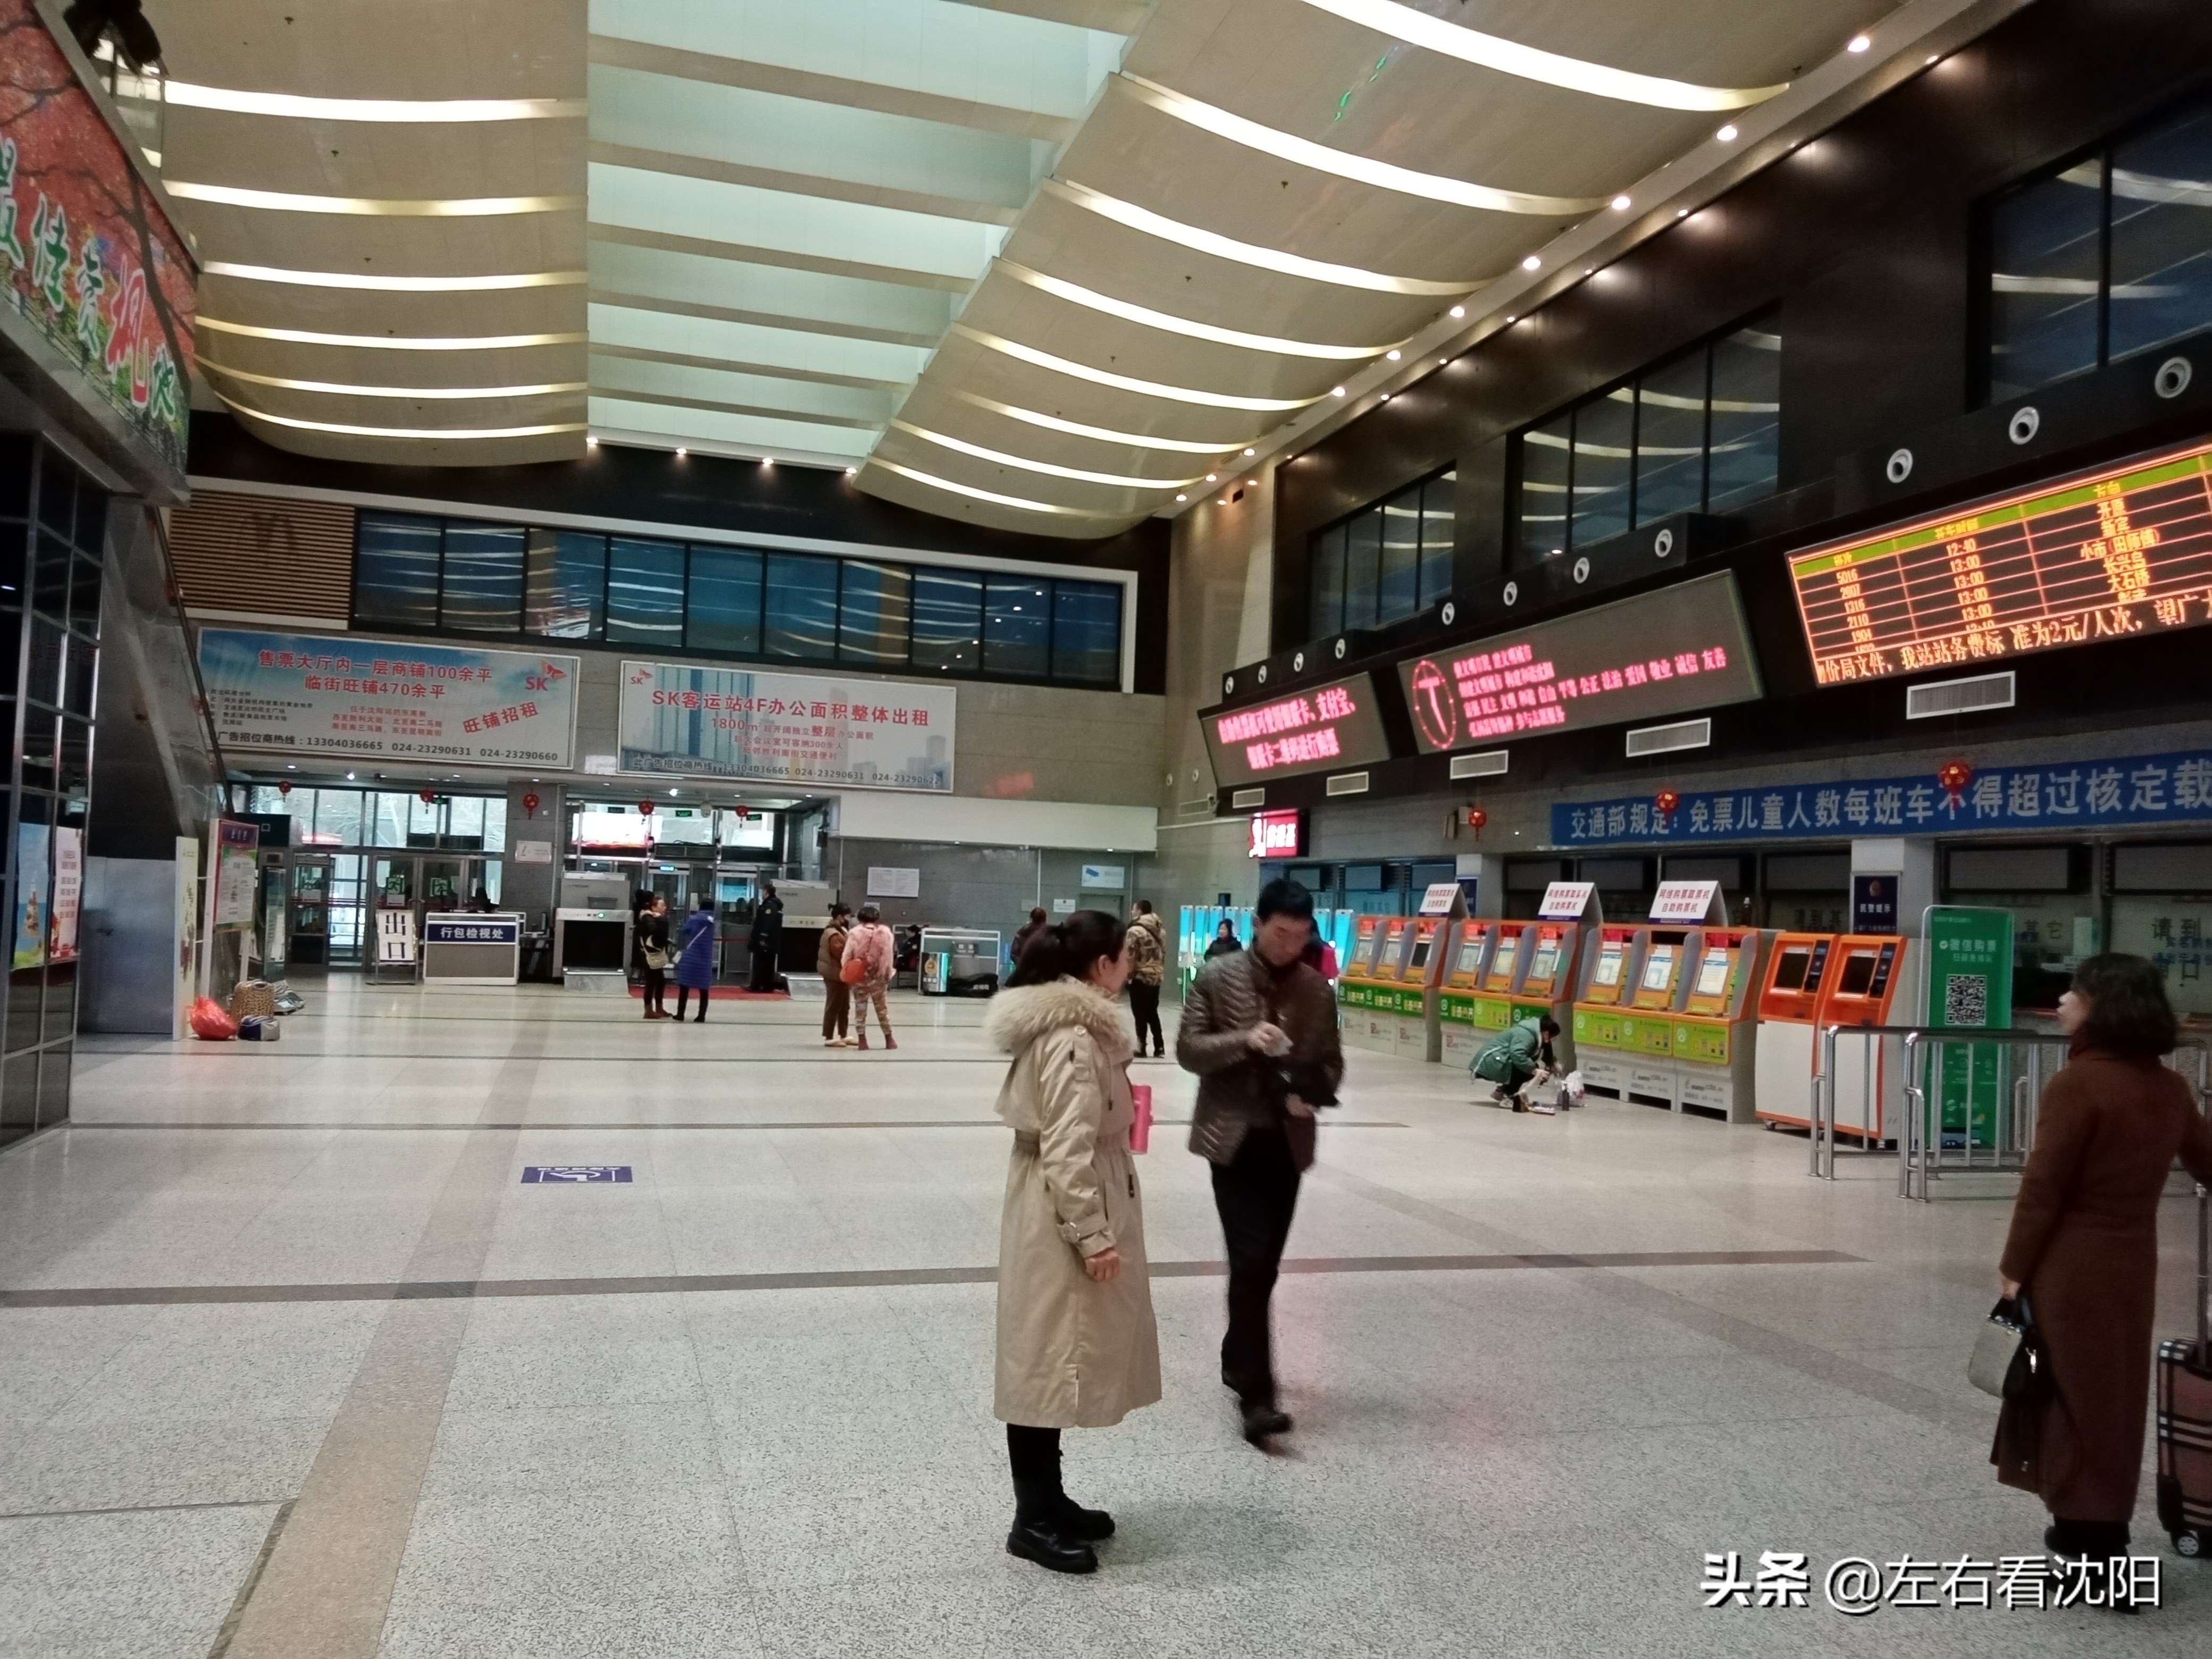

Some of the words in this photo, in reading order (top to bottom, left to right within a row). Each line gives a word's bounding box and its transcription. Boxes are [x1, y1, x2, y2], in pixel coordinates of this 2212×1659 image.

[2094, 481, 2121, 498] 方向
[1836, 568, 1859, 584] 5016
[1946, 538, 1976, 557] 12:40
[2097, 498, 2125, 520] 开原
[1950, 555, 1980, 573] 13:00
[2101, 516, 2130, 538] 新宾
[1844, 599, 1865, 614] 1316
[1954, 571, 1984, 589] 13:00
[1962, 604, 1992, 621] 13:00
[2108, 568, 2150, 593] 大石桥
[1847, 613, 1869, 629] 2110
[1958, 587, 1989, 606] 13:00
[258, 649, 493, 682] 售票大厅内一层商铺100余平
[1557, 678, 1578, 699] 平等
[1579, 675, 1601, 695] 公正
[1601, 669, 1623, 691] 法治
[1624, 664, 1647, 686] 爱国
[1649, 658, 1673, 681] 敬业
[1674, 652, 1699, 676] 诚信
[1702, 646, 1727, 671] 友善
[305, 675, 446, 699] 临街旺铺470余平
[525, 676, 549, 691] SK
[630, 676, 643, 685] SK
[463, 702, 539, 734] 旺铺招租
[652, 690, 928, 726] SK客运站4F办公面积整体出租
[391, 742, 471, 757] 024-23290631
[480, 748, 558, 761] 024-23290660
[795, 768, 865, 781] 024-23290631
[1658, 889, 1710, 900] 网络购票取票机
[1661, 902, 1698, 913] 自助购票机
[1860, 903, 1891, 913] 民警提示
[385, 912, 406, 959] 出口
[440, 926, 505, 941] 行包检视处
[1949, 939, 1996, 952] 微信购票
